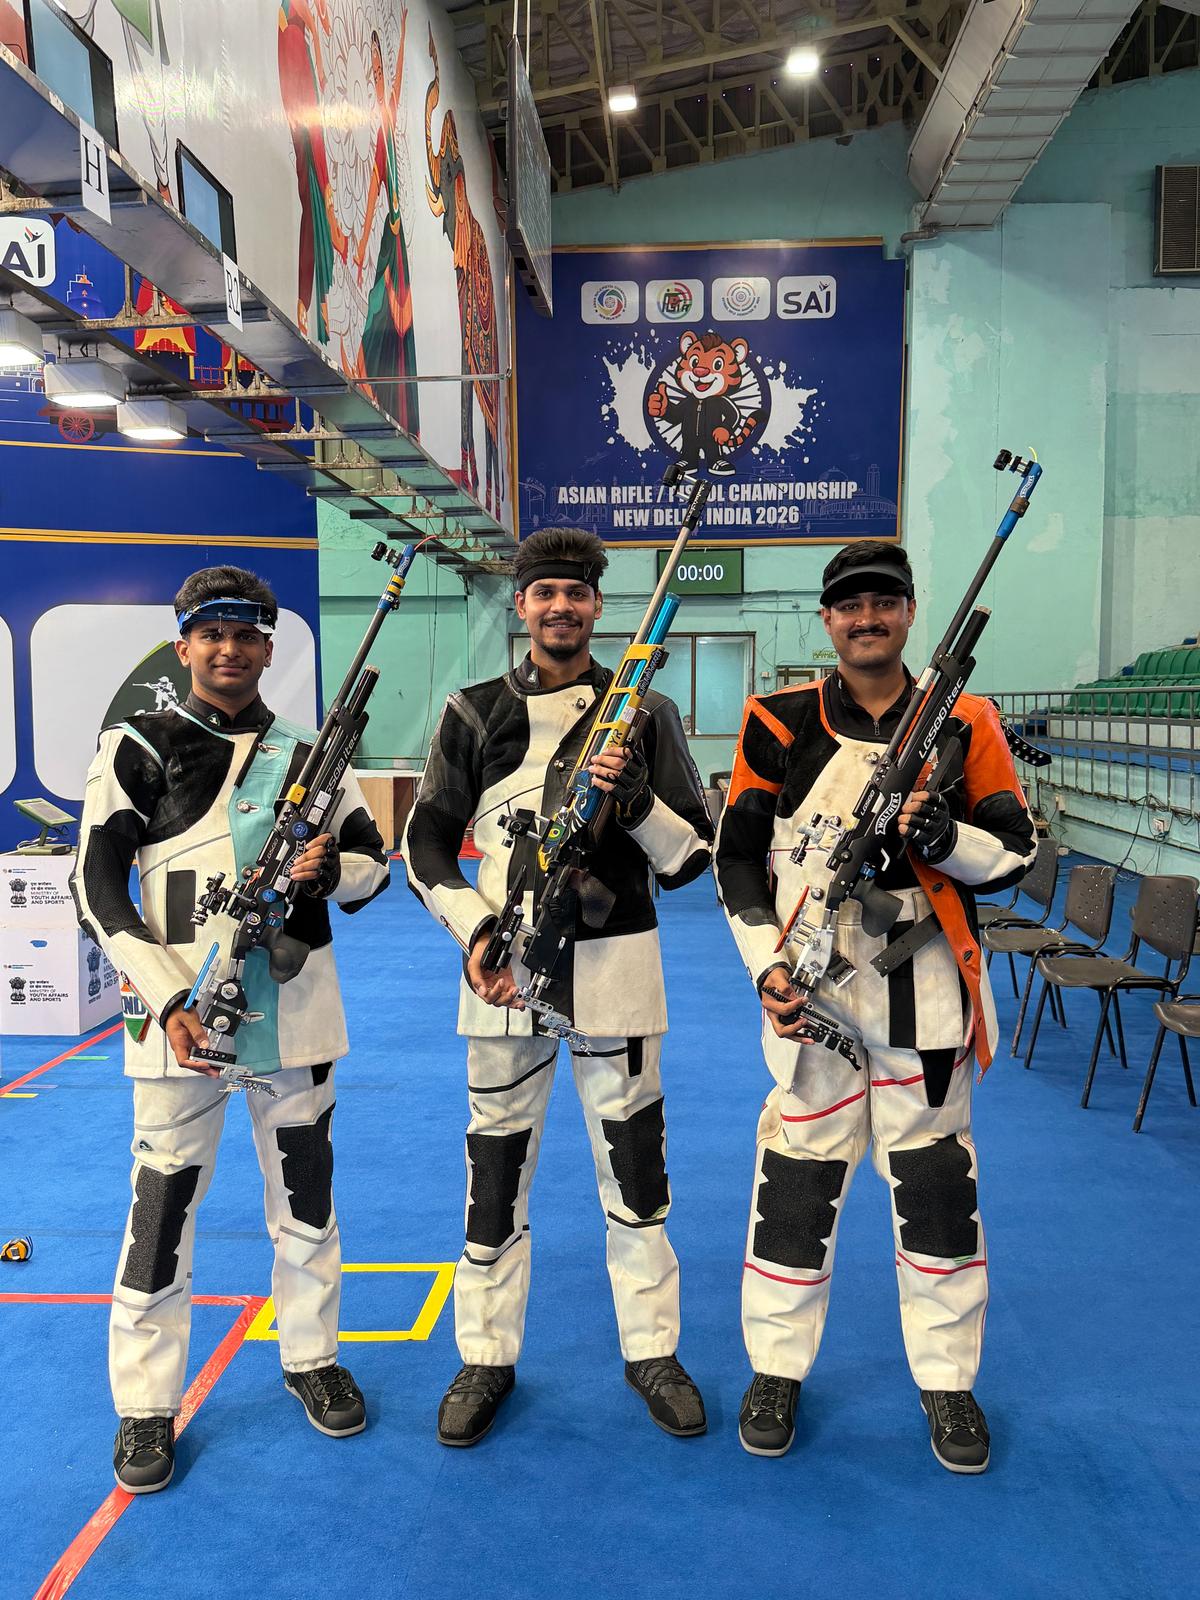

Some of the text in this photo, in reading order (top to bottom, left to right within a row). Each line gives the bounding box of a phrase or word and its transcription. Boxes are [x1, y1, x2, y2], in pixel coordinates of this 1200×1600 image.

[82, 135, 105, 195] H
[226, 269, 241, 317] R2
[782, 290, 831, 315] SAI
[558, 486, 607, 504] ASIAN
[611, 485, 653, 504] RIFLE
[668, 484, 726, 503] PISOL
[728, 481, 858, 502] CHAMPIONSHIP
[613, 508, 650, 527] NEW
[706, 507, 752, 525] INDIA
[755, 505, 800, 524] 2026
[677, 564, 724, 581] 00:00
[918, 676, 964, 759] LG500 itec
[325, 757, 346, 795] G500
[877, 798, 899, 829] WALTHER
